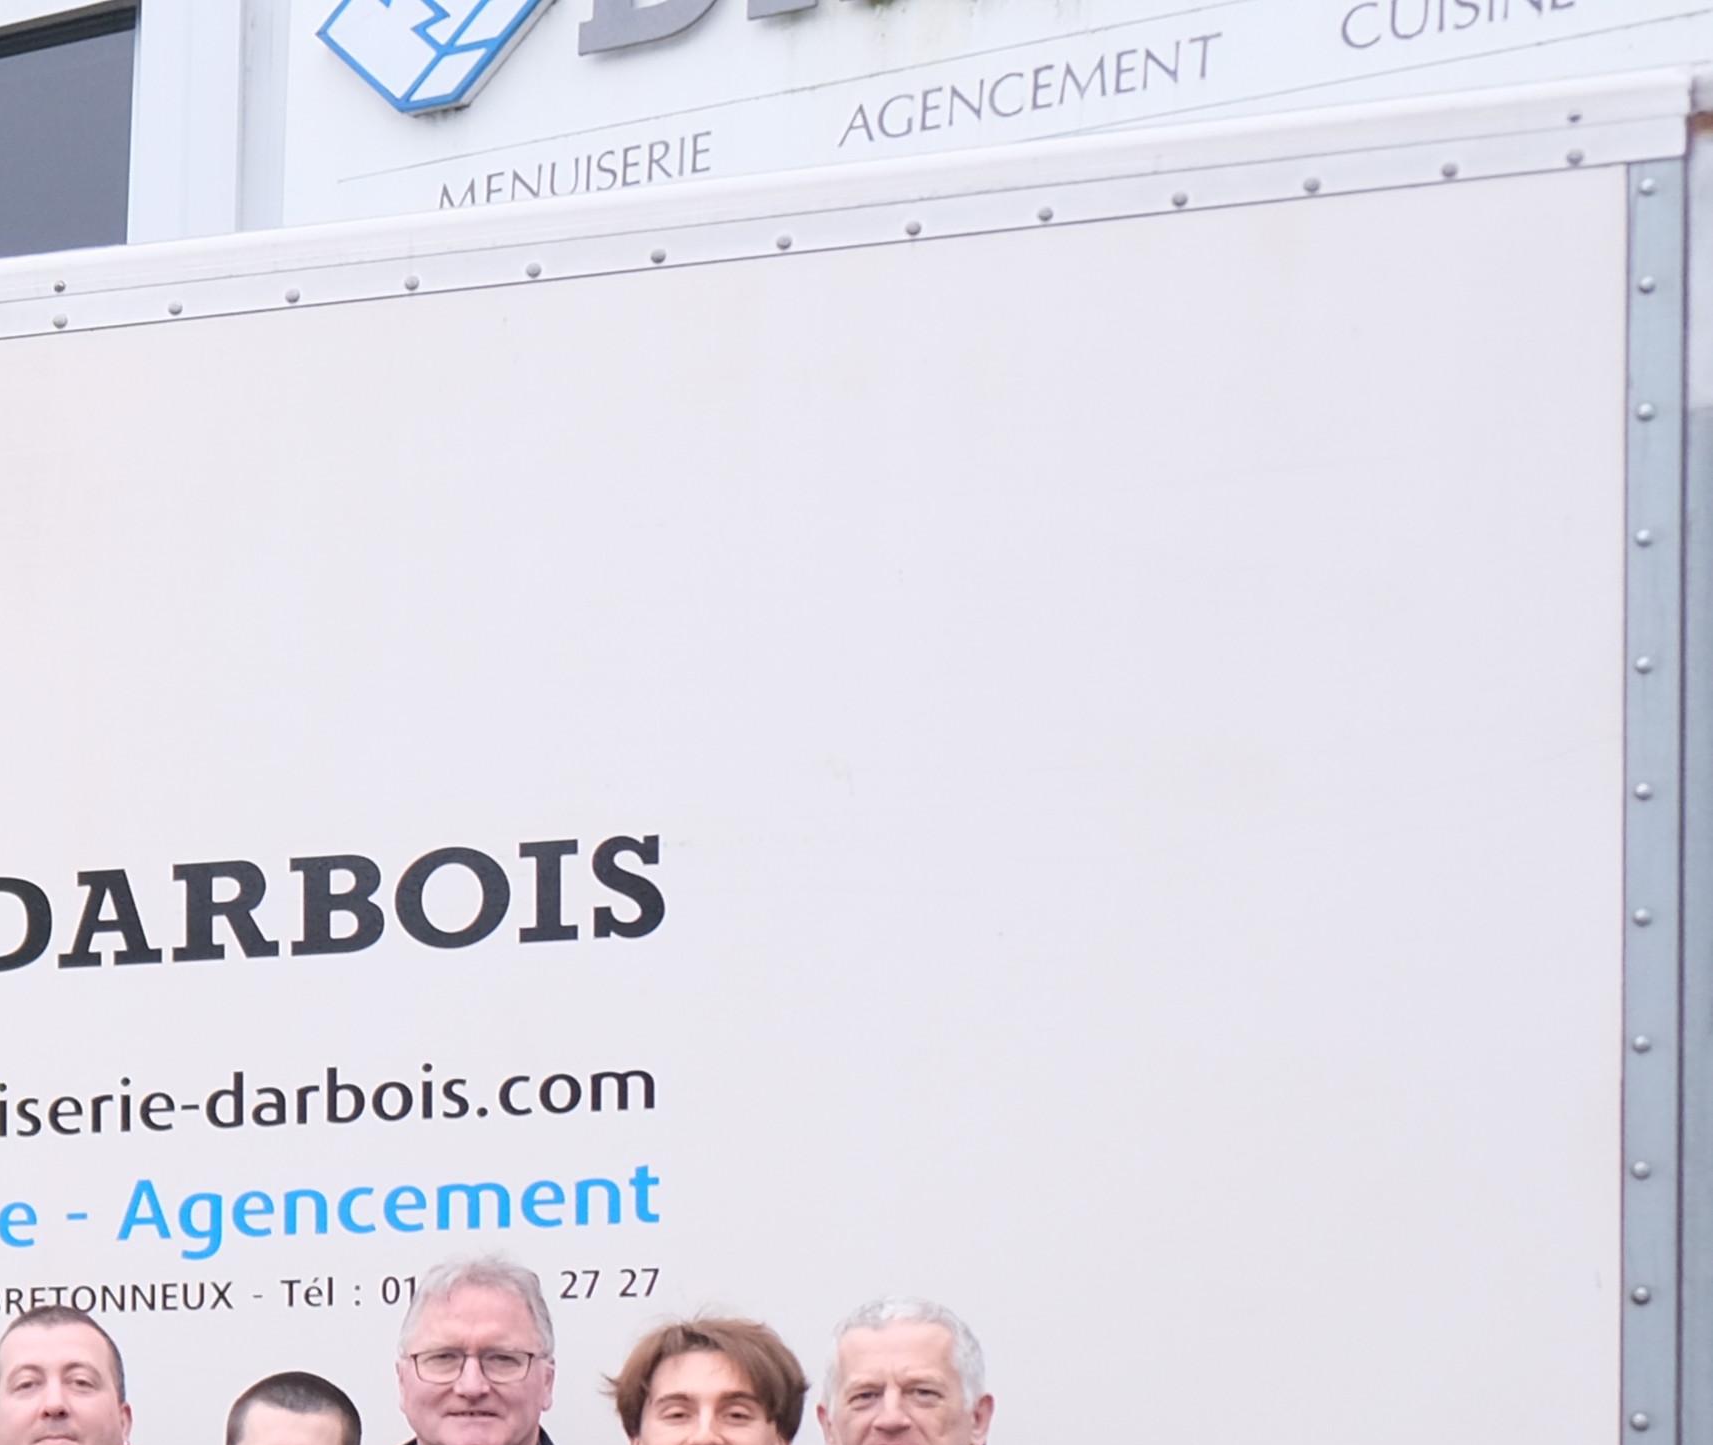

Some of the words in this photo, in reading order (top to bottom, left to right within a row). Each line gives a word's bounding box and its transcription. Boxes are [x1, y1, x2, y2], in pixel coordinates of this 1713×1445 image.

[439, 130, 712, 209] MENUISERIE
[837, 32, 1223, 148] AGENCEMENT
[117, 1164, 660, 1260] Agencement
[280, 1276, 334, 1308] Tél
[381, 1276, 416, 1305] 01
[559, 1269, 601, 1300] 27
[618, 1267, 660, 1298] 27
